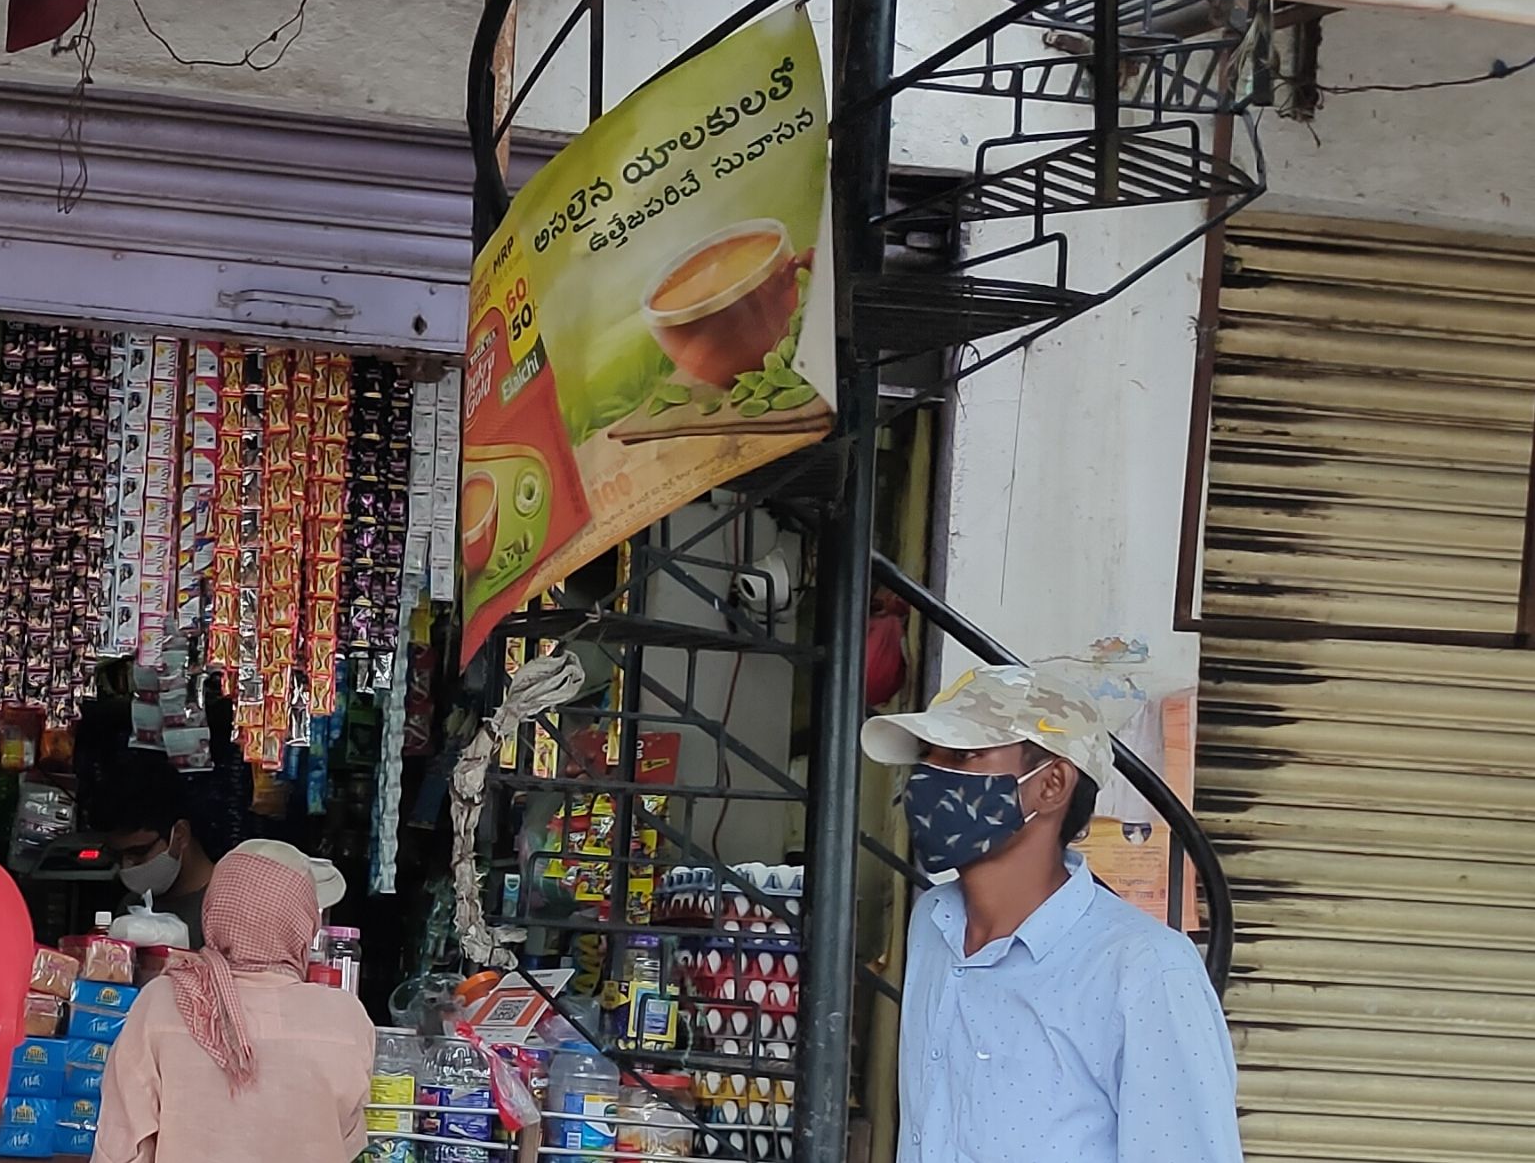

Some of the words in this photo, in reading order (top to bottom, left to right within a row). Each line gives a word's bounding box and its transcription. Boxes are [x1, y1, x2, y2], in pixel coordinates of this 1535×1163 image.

[533, 176, 614, 253] అసలైన
[623, 57, 794, 184] యాలకులతో
[711, 108, 814, 179] సువాసన
[492, 236, 514, 274] MRP
[466, 351, 496, 390] hakra
[466, 371, 492, 419] Gold
